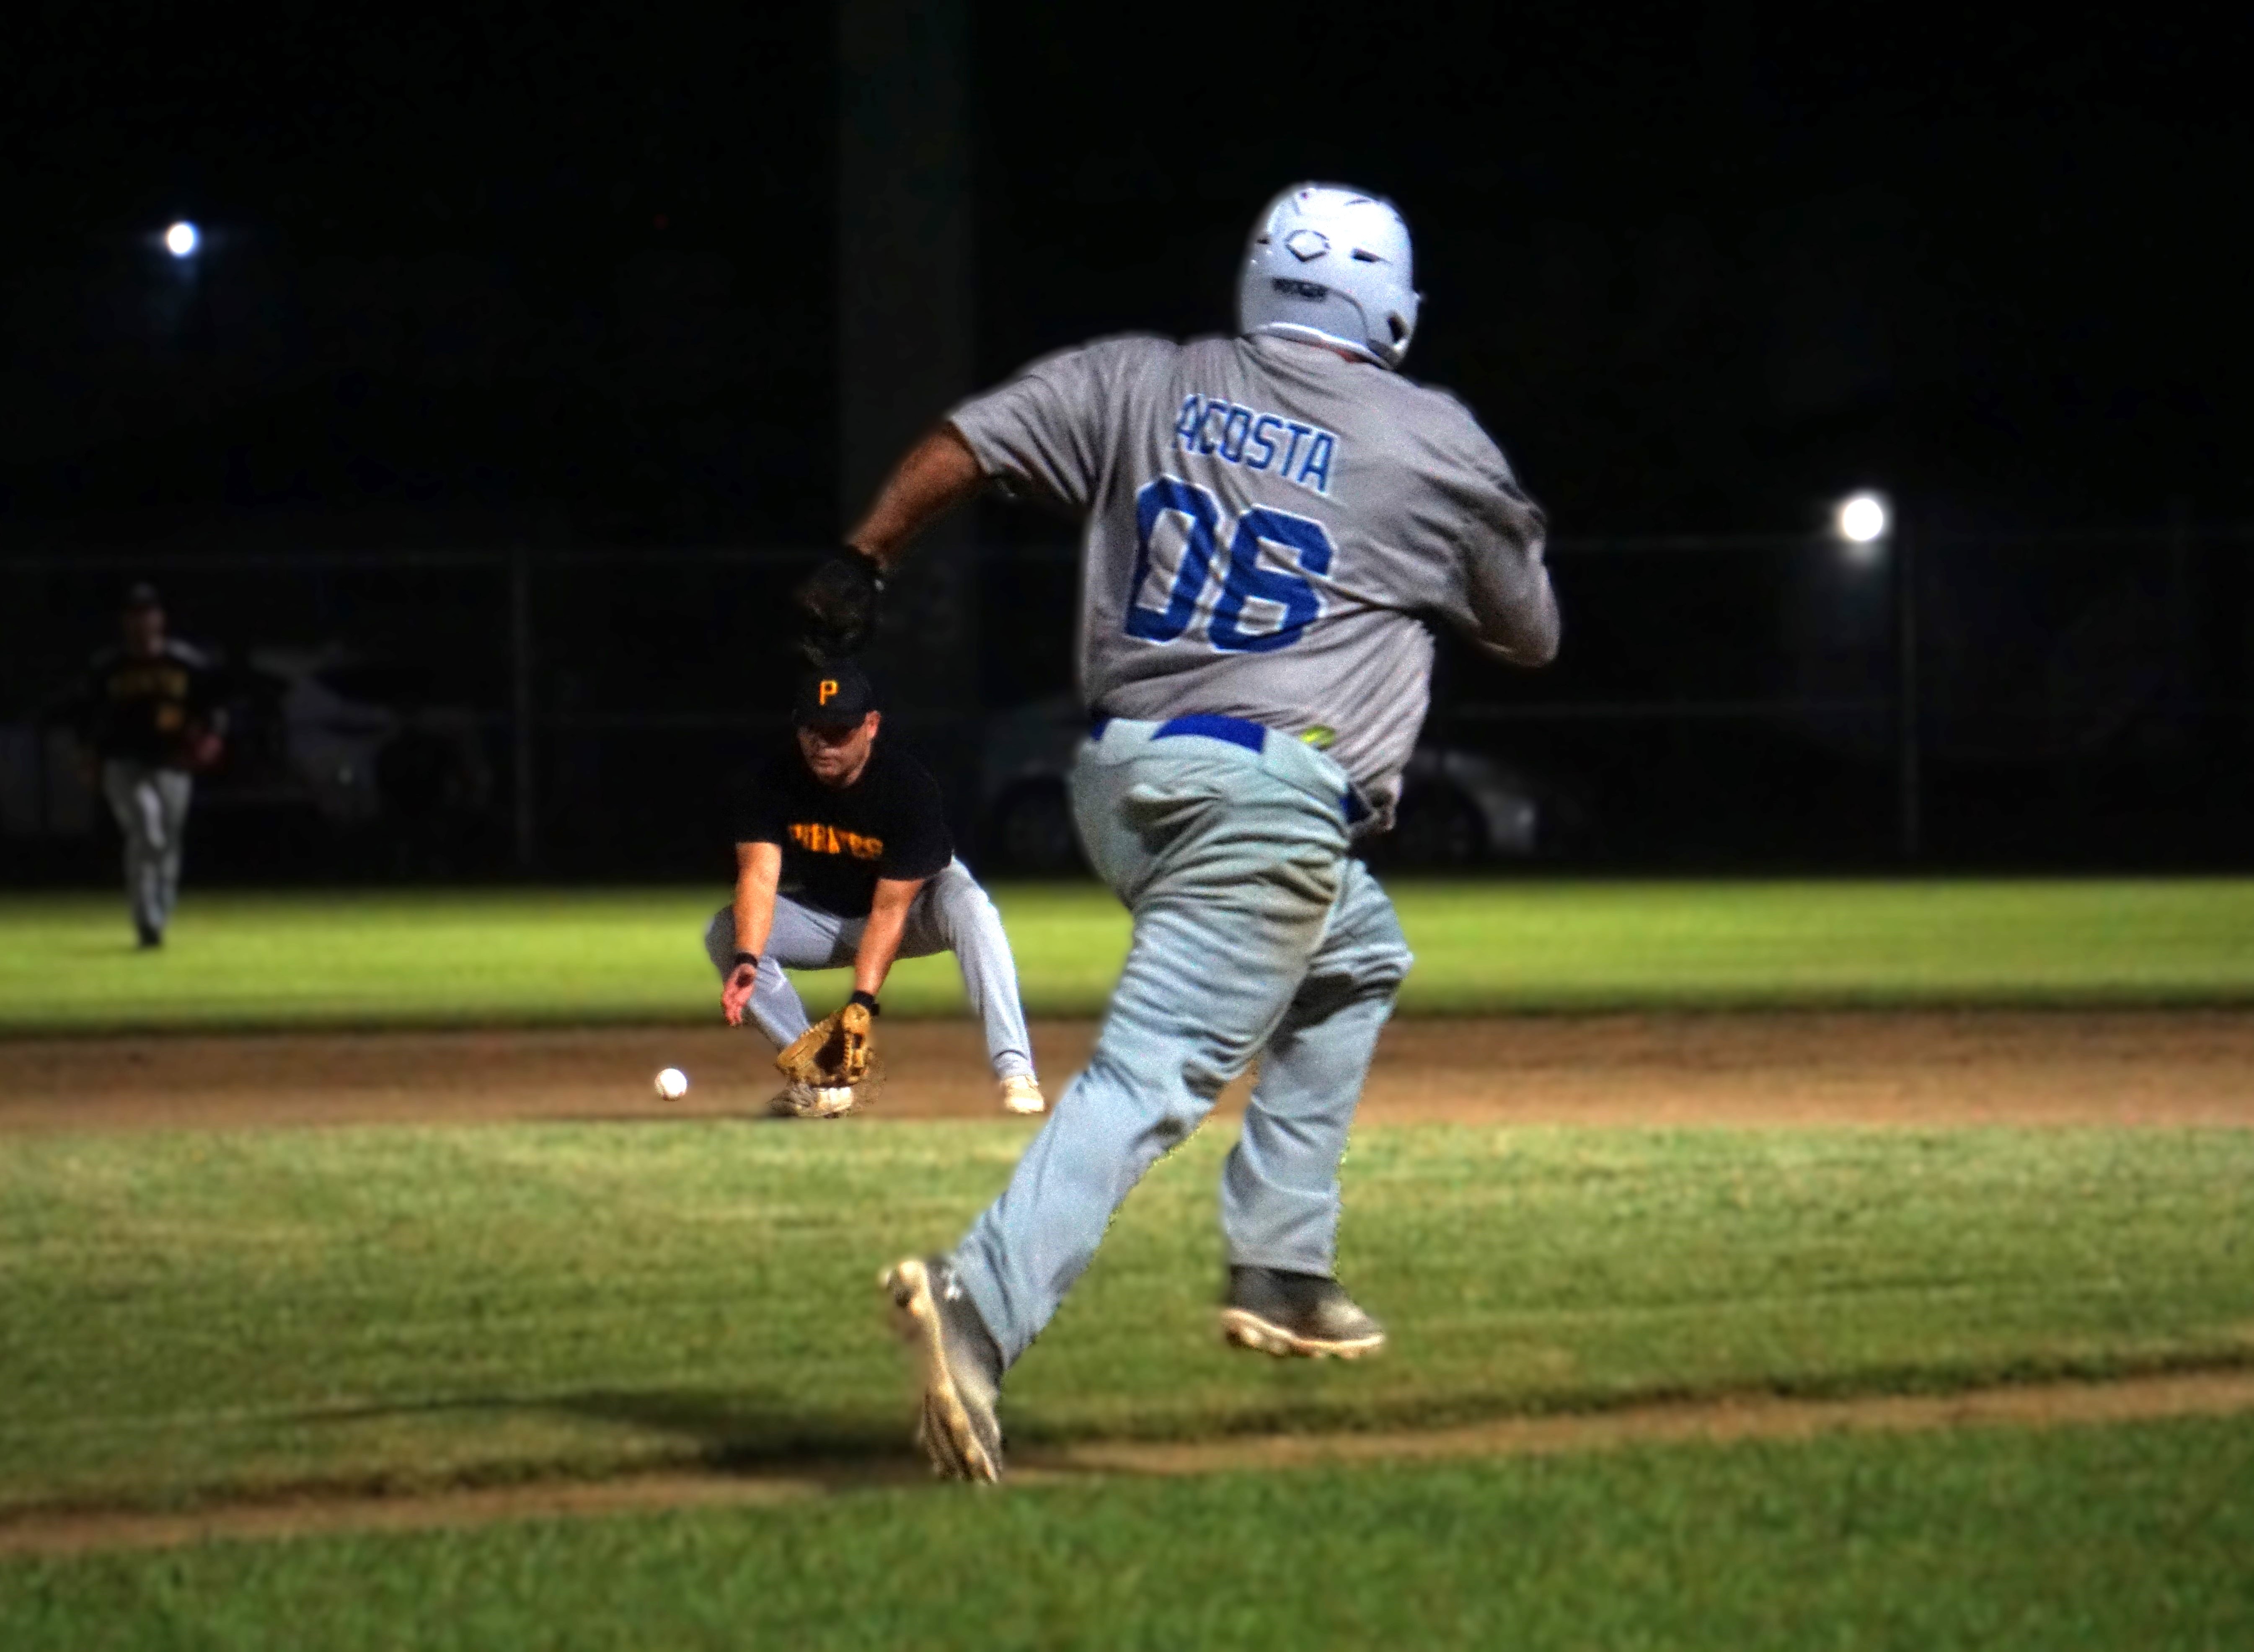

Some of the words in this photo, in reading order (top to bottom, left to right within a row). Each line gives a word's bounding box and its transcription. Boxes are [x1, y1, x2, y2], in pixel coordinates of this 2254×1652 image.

[1175, 394, 1337, 496] ACOSTA
[1124, 474, 1334, 653] 06
[819, 679, 838, 706] P
